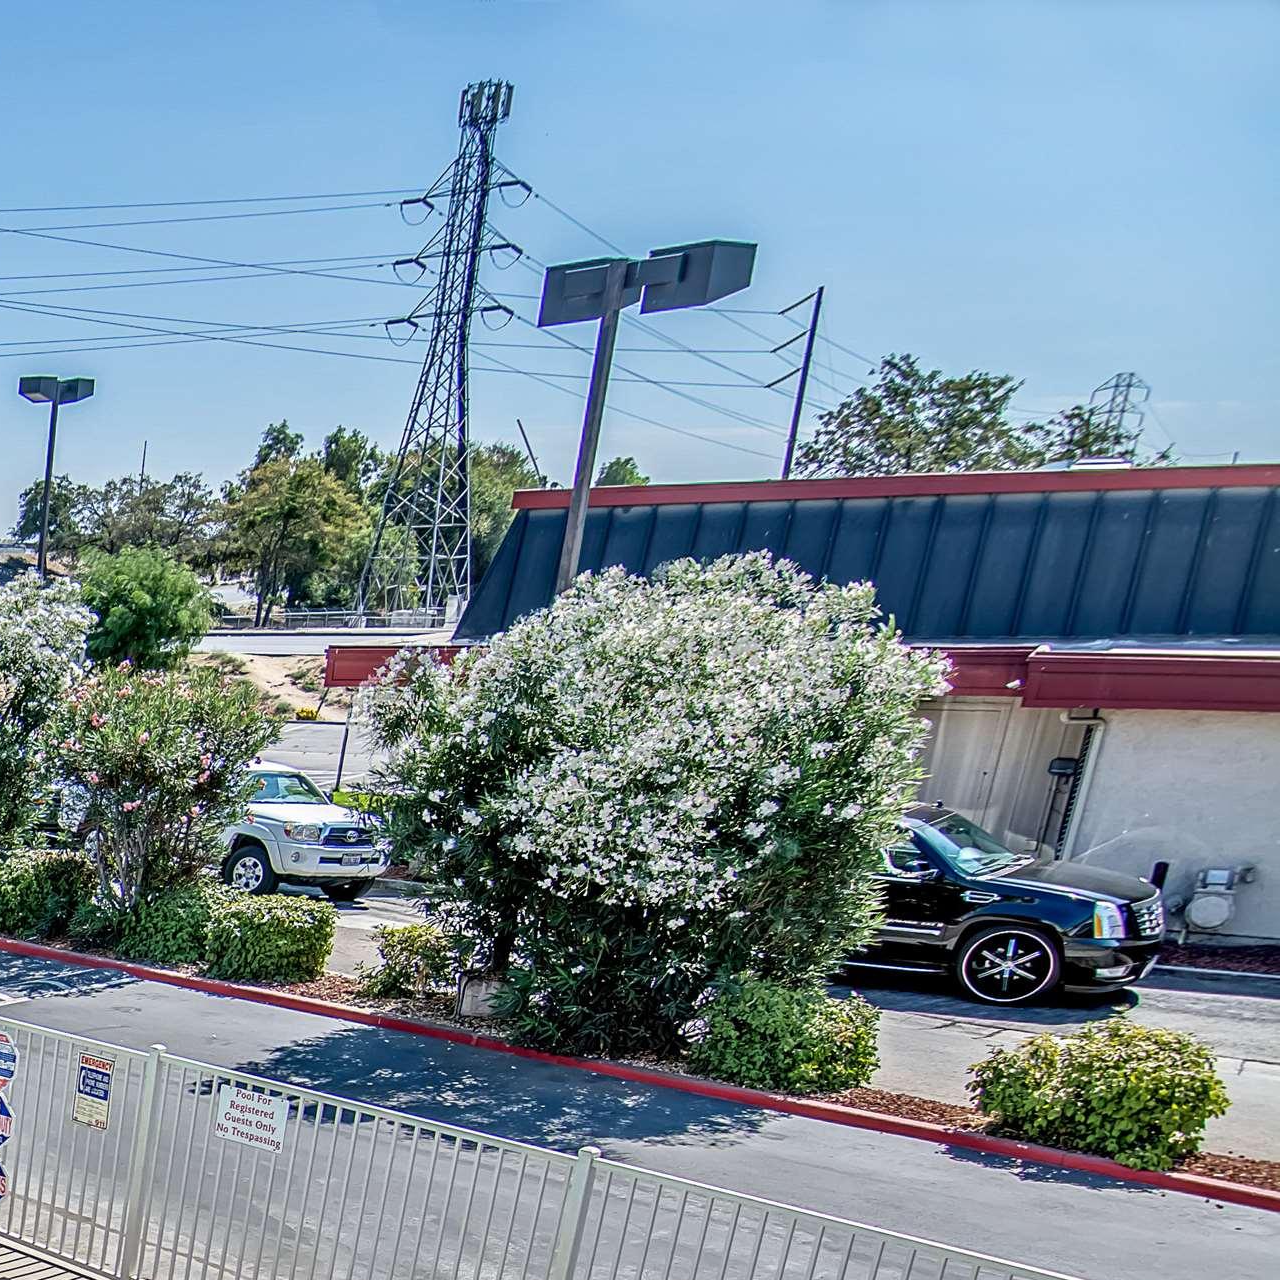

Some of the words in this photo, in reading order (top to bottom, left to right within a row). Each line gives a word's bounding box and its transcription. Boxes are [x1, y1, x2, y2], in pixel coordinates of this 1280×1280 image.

[81, 1055, 113, 1071] EMERGENCY
[236, 1089, 255, 1102] Pool
[257, 1094, 273, 1106] For
[229, 1100, 275, 1120] Registered
[224, 1112, 253, 1127] Guests
[255, 1120, 277, 1135] Only
[216, 1122, 229, 1134] No
[231, 1126, 281, 1151] Trespassing
